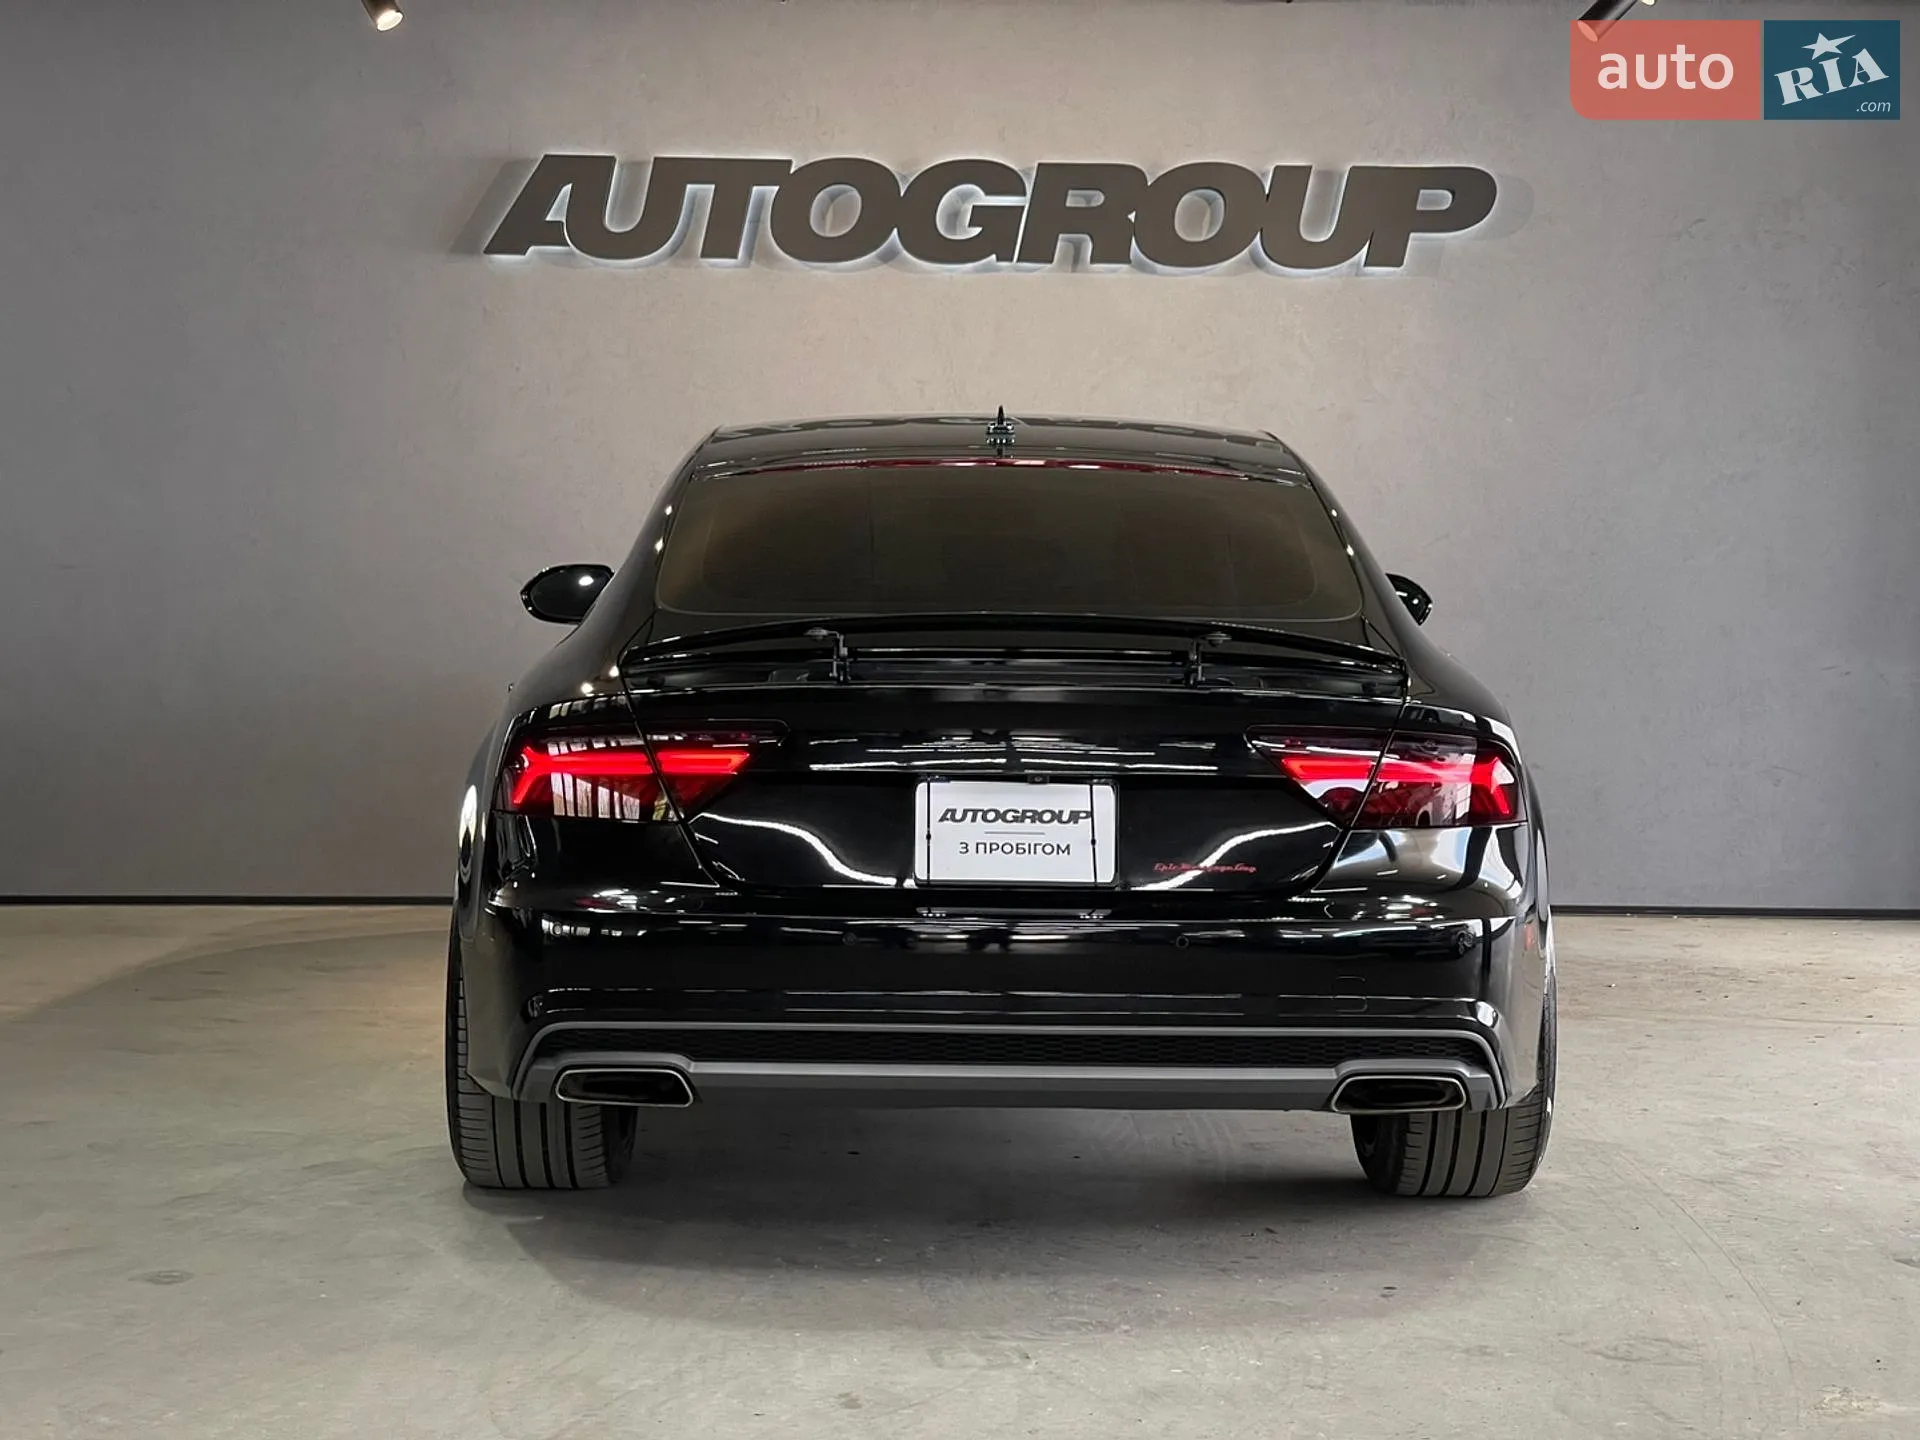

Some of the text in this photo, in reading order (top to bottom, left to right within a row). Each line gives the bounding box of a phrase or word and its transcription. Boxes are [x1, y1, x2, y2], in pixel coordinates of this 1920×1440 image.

[483, 153, 1498, 269] AUTOGROUP
[938, 808, 1092, 825] AUTOGROUP
[975, 842, 1071, 856] ПРОБІГОМ
